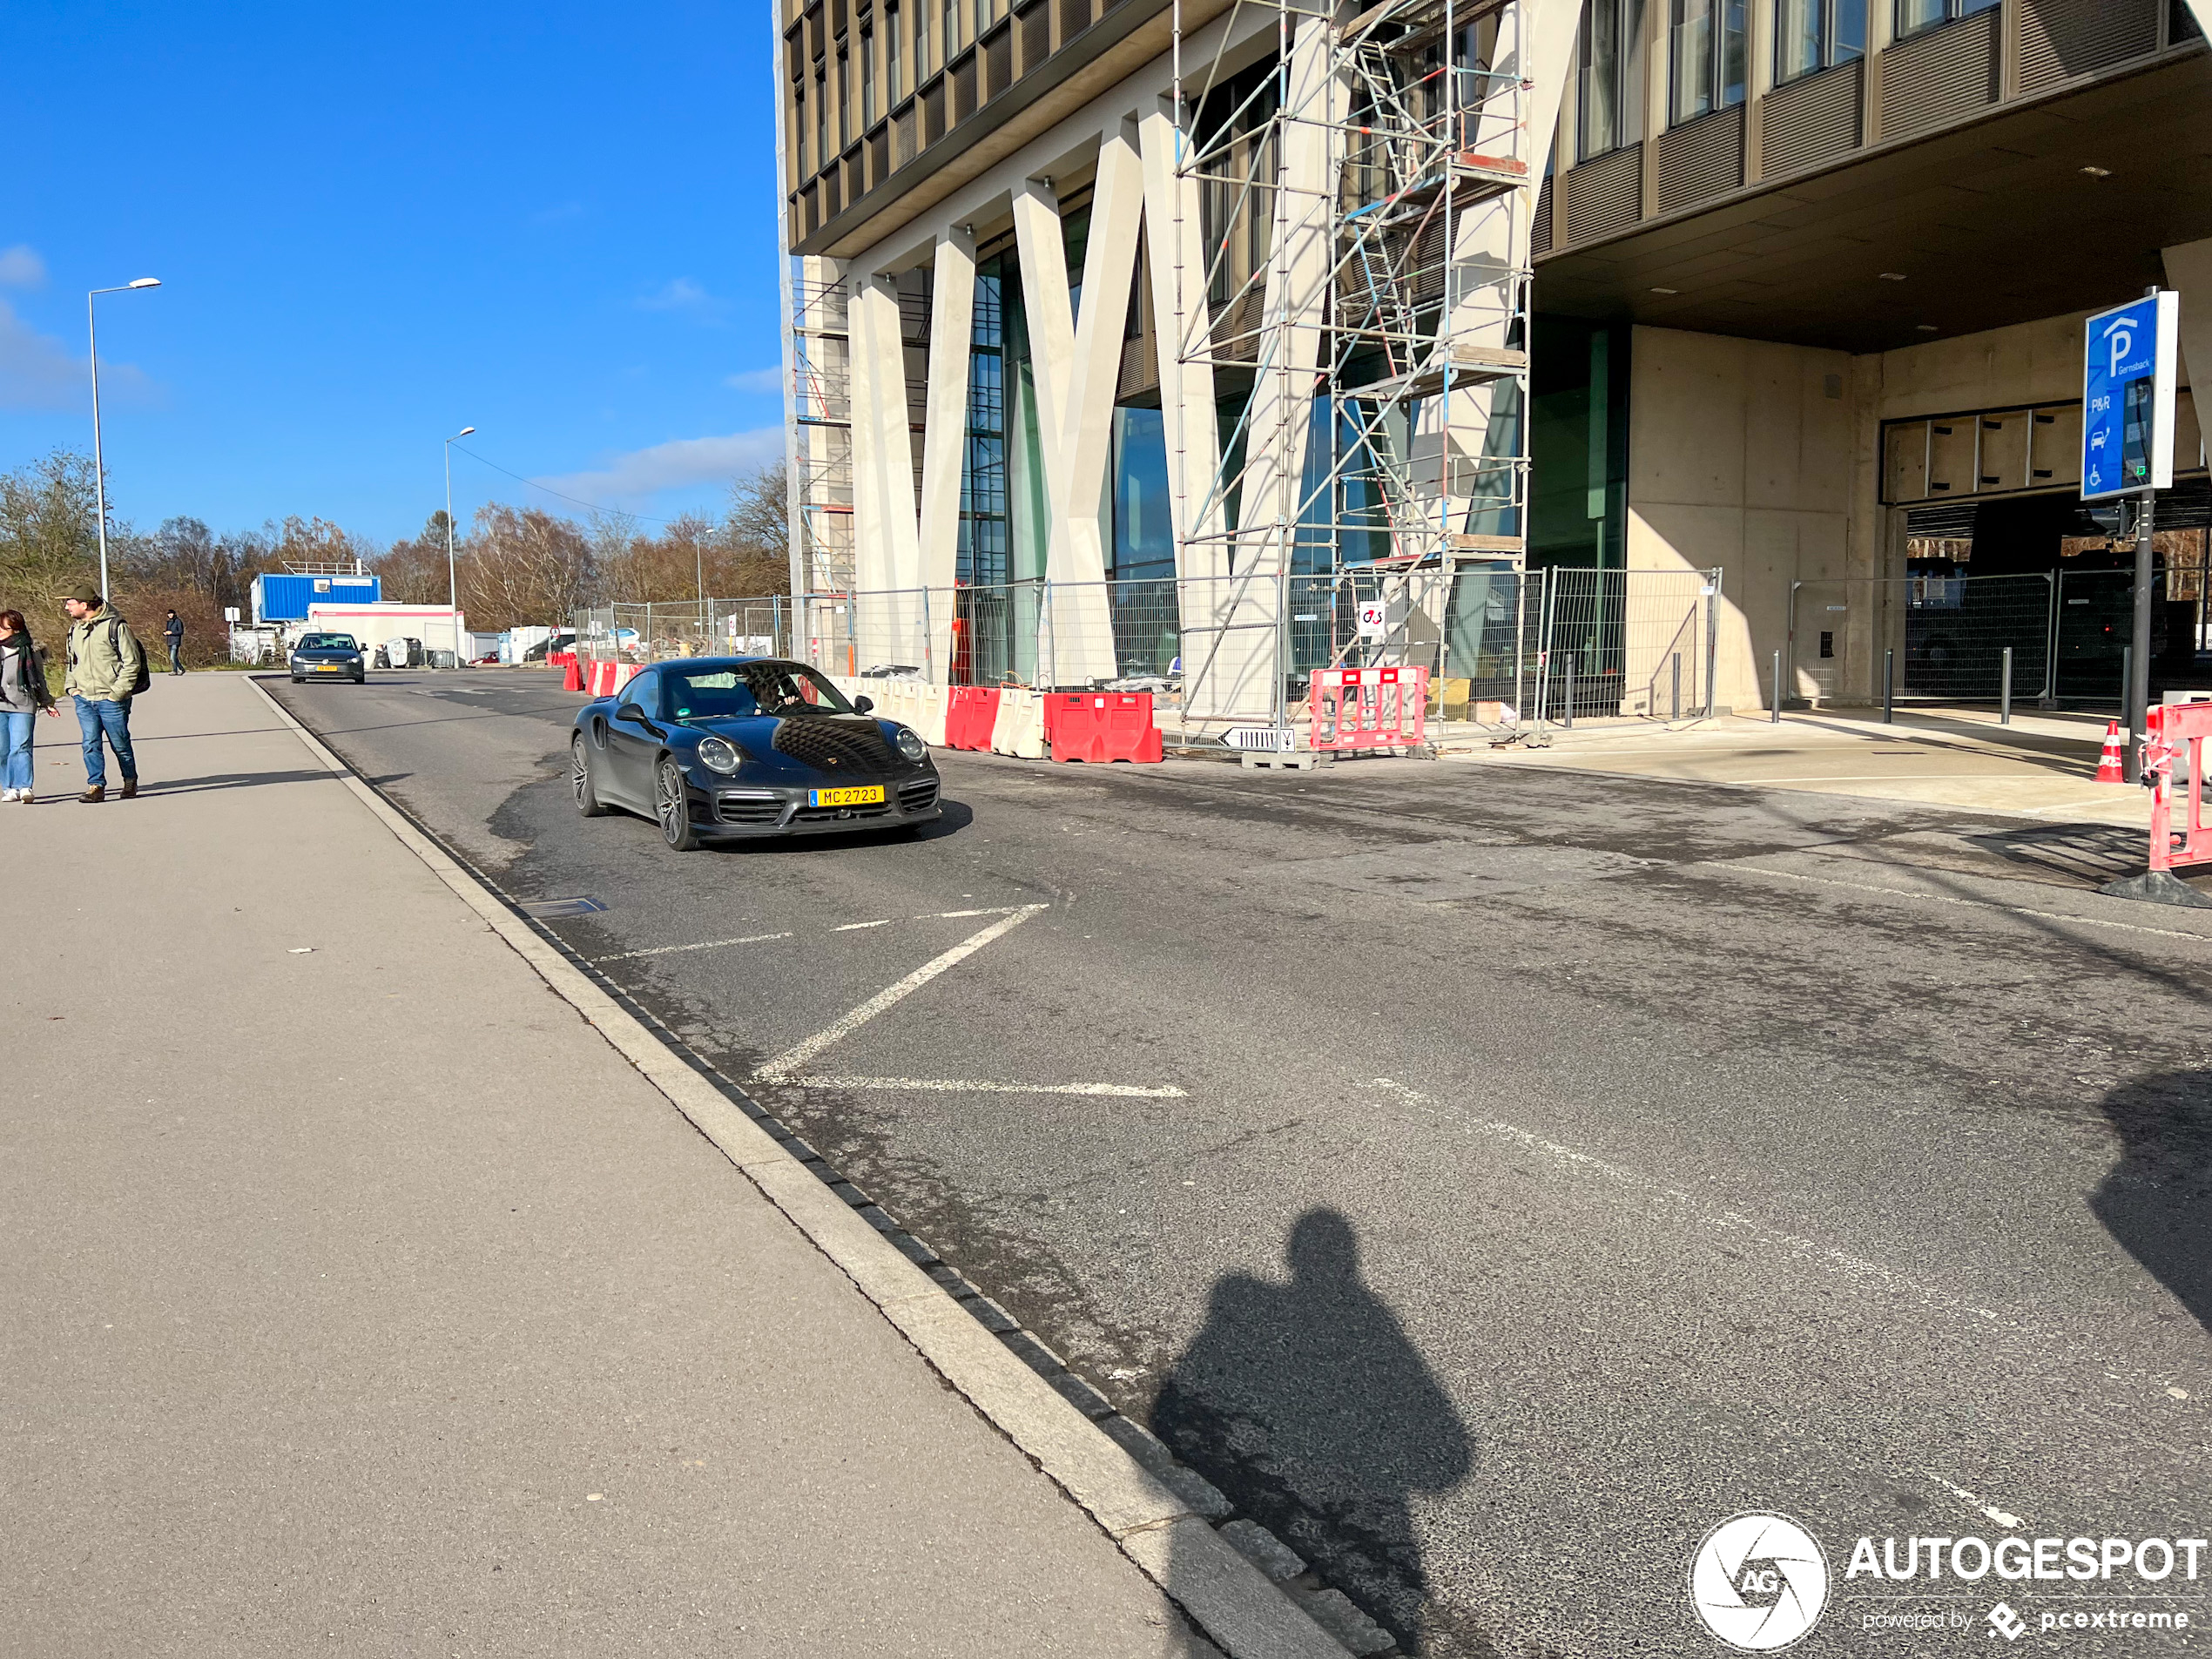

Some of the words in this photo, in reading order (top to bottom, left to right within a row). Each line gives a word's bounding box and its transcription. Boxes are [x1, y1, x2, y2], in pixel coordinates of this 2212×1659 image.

[2111, 330, 2131, 377] P
[2118, 358, 2150, 375] Gernsback
[2092, 395, 2111, 413] P&R
[825, 791, 840, 803] MC
[845, 789, 877, 802] 2723
